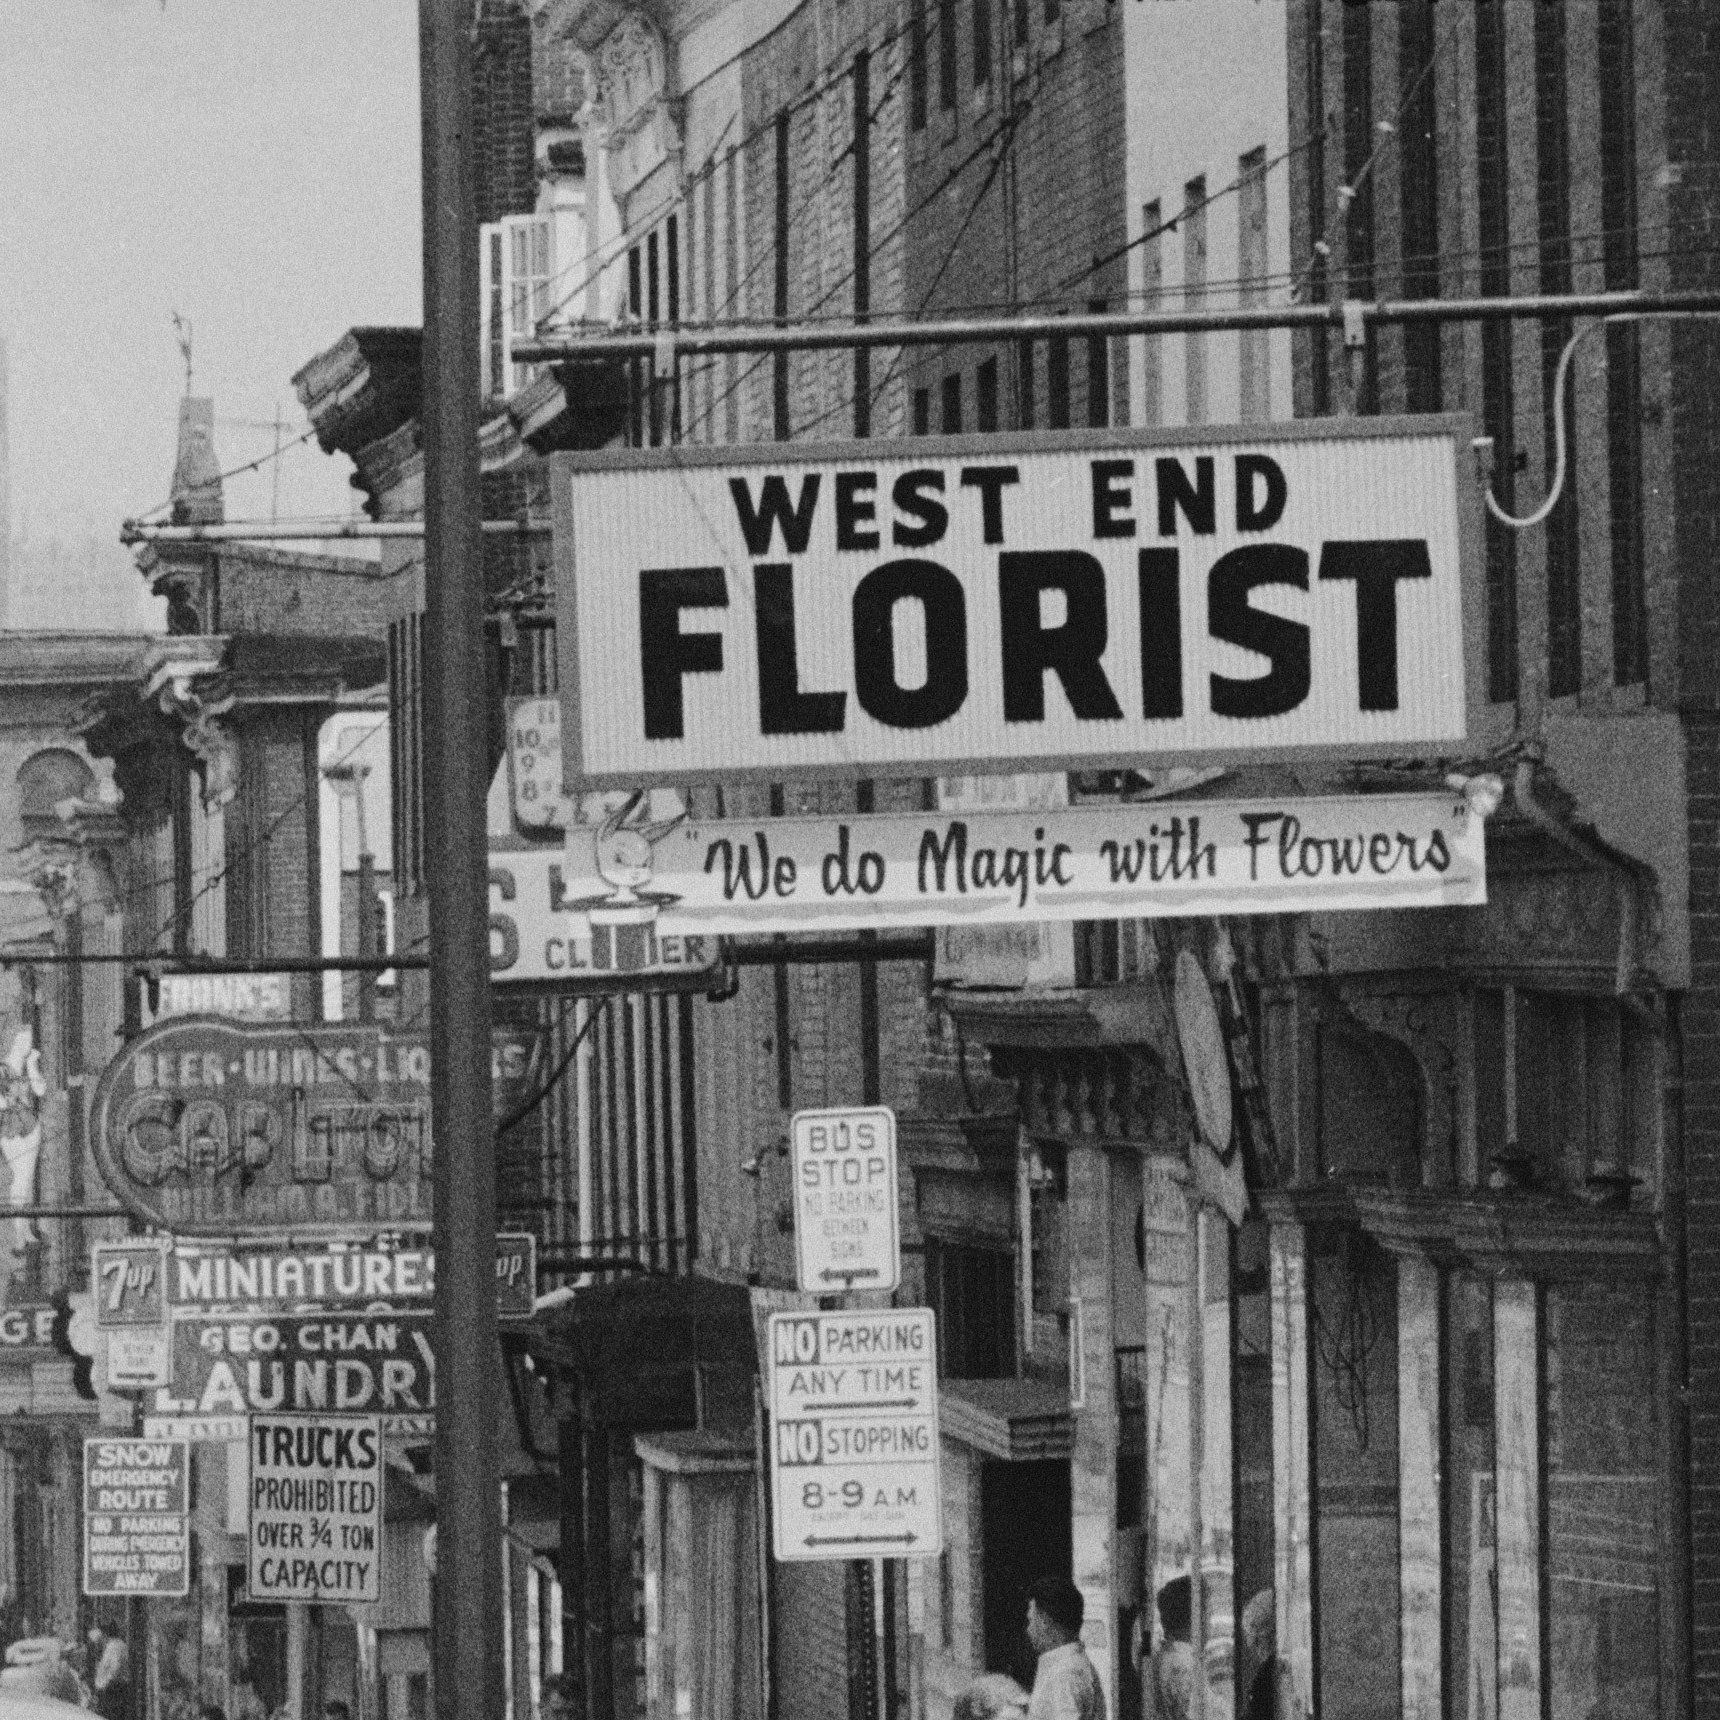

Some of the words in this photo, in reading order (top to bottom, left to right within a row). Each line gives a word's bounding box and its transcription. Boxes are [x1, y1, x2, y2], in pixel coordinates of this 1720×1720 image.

[728, 464, 1020, 557] WEST
[1090, 452, 1288, 541] END
[638, 538, 1432, 740] FLORIST
[515, 727, 541, 749] 10
[822, 823, 887, 896] do
[917, 820, 1074, 908] Magic
[1099, 812, 1217, 884] with
[545, 934, 706, 971] CLER
[134, 1051, 224, 1087] BEER
[244, 1048, 357, 1085] WINES
[124, 1091, 432, 1187] CARLTO
[809, 1122, 876, 1153] BUS
[802, 1156, 886, 1188] STOP
[804, 1191, 822, 1216] NO
[177, 1254, 435, 1299] MINIATURE
[200, 1324, 287, 1353] GEO.
[297, 1323, 398, 1351] CHAN
[777, 1321, 815, 1365] NO
[826, 1324, 923, 1357] PARKING
[788, 1369, 847, 1396] ANY
[857, 1366, 922, 1393] TIME
[97, 1445, 172, 1467] SNOW
[254, 1424, 377, 1470] TRUCKS
[779, 1421, 821, 1463] NO
[826, 1425, 929, 1455] STOPPING
[90, 1469, 179, 1488] EMERGENCY
[99, 1489, 169, 1512] ROUTE
[254, 1477, 376, 1515] PROHIBITED
[801, 1480, 864, 1510] 8-9
[92, 1517, 113, 1534] NO
[120, 1517, 181, 1533] PARKING
[257, 1521, 304, 1549] OVER
[340, 1524, 375, 1551] TON
[92, 1554, 140, 1572] VEHICLES
[144, 1554, 183, 1571] TOWED
[259, 1557, 371, 1591] CAPACITY
[114, 1573, 159, 1590] AWAY
